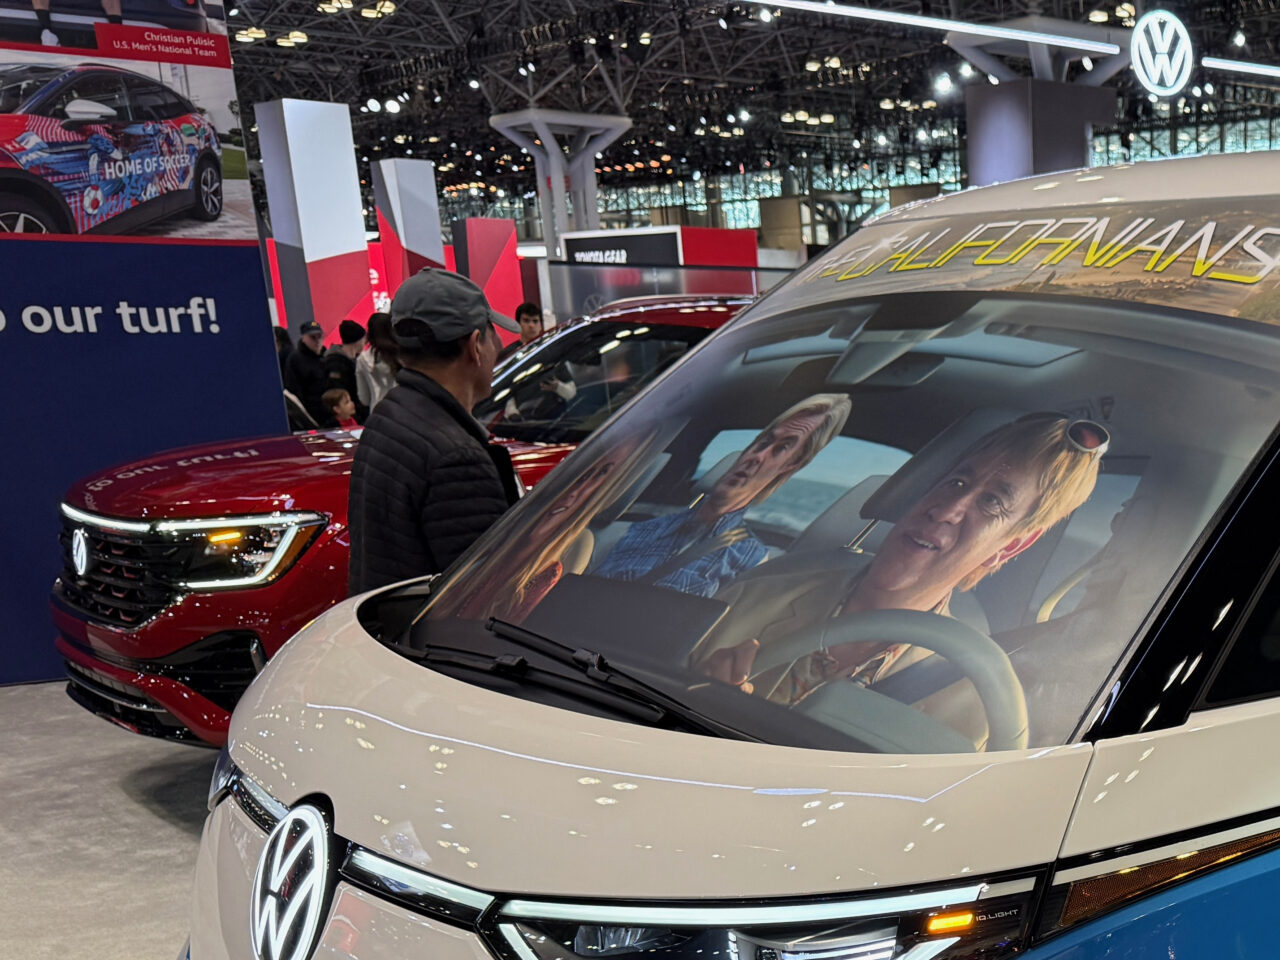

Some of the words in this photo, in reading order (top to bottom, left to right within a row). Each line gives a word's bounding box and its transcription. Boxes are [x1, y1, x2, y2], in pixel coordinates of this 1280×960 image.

[144, 31, 185, 44] Christian
[187, 35, 215, 47] Pulisic
[113, 40, 130, 49] U.S.
[132, 42, 157, 52] Men's
[158, 45, 192, 55] National
[194, 47, 217, 57] Team
[104, 159, 142, 179] HOME
[144, 157, 158, 172] OF
[159, 154, 190, 171] SOCCER
[21, 304, 103, 334] our
[115, 296, 220, 334] turf!
[976, 909, 1018, 921] IQ.LIGHT
